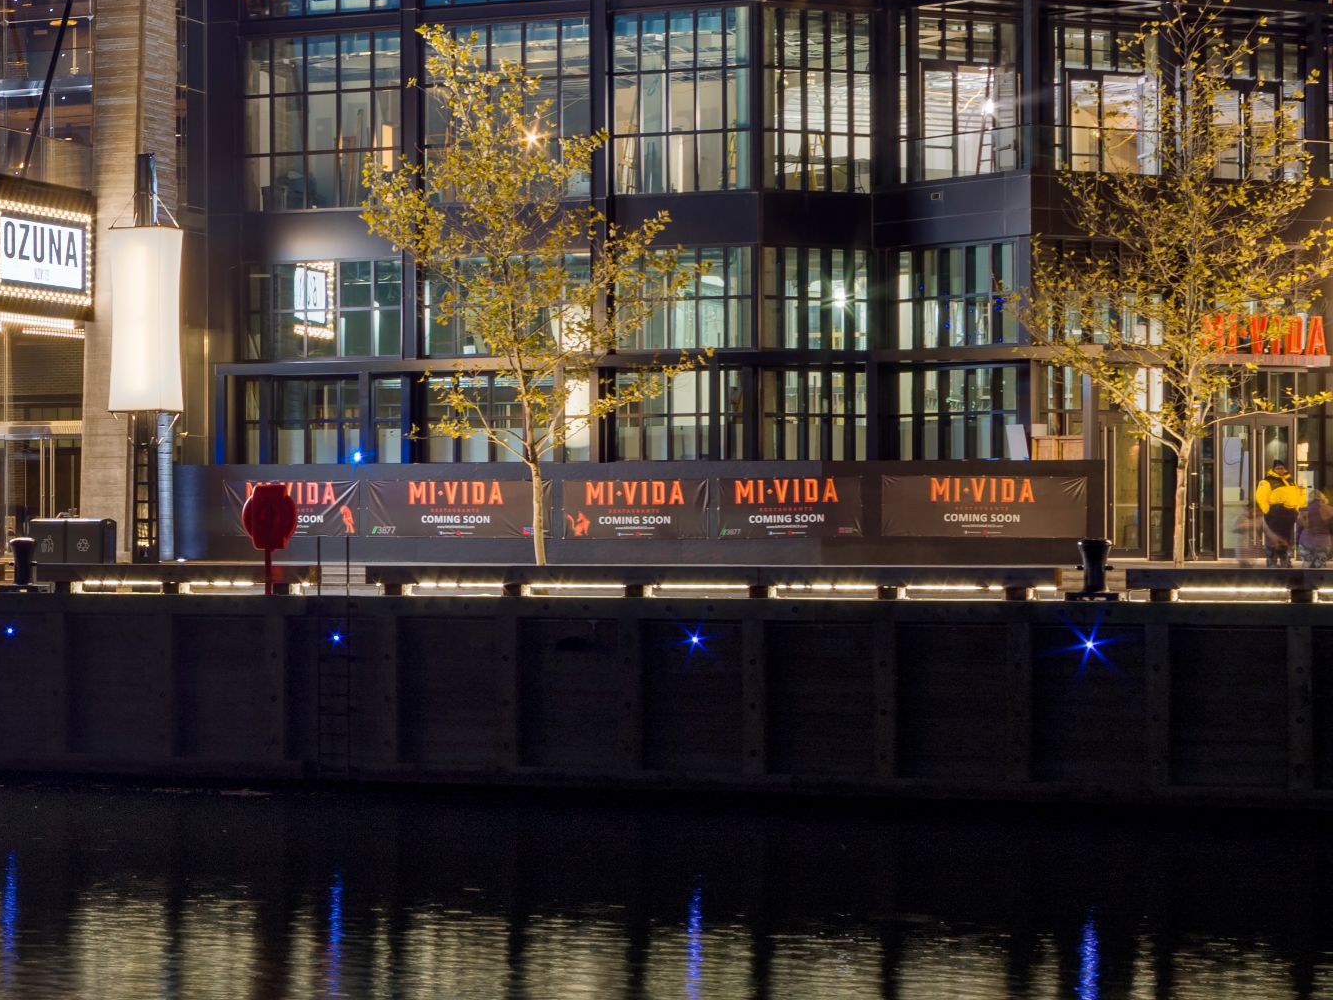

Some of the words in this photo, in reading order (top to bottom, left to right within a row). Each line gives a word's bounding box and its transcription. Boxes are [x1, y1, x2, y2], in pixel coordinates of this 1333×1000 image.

[3, 221, 78, 268] OZUNA
[297, 515, 323, 524] SOON
[421, 515, 461, 524] COMING
[463, 515, 491, 524] SOON
[598, 516, 640, 525] COMING
[642, 516, 672, 525] SOON
[748, 514, 792, 524] COMING
[794, 513, 825, 522] SOON
[943, 513, 987, 522] COMING
[990, 513, 1021, 523] SOON
